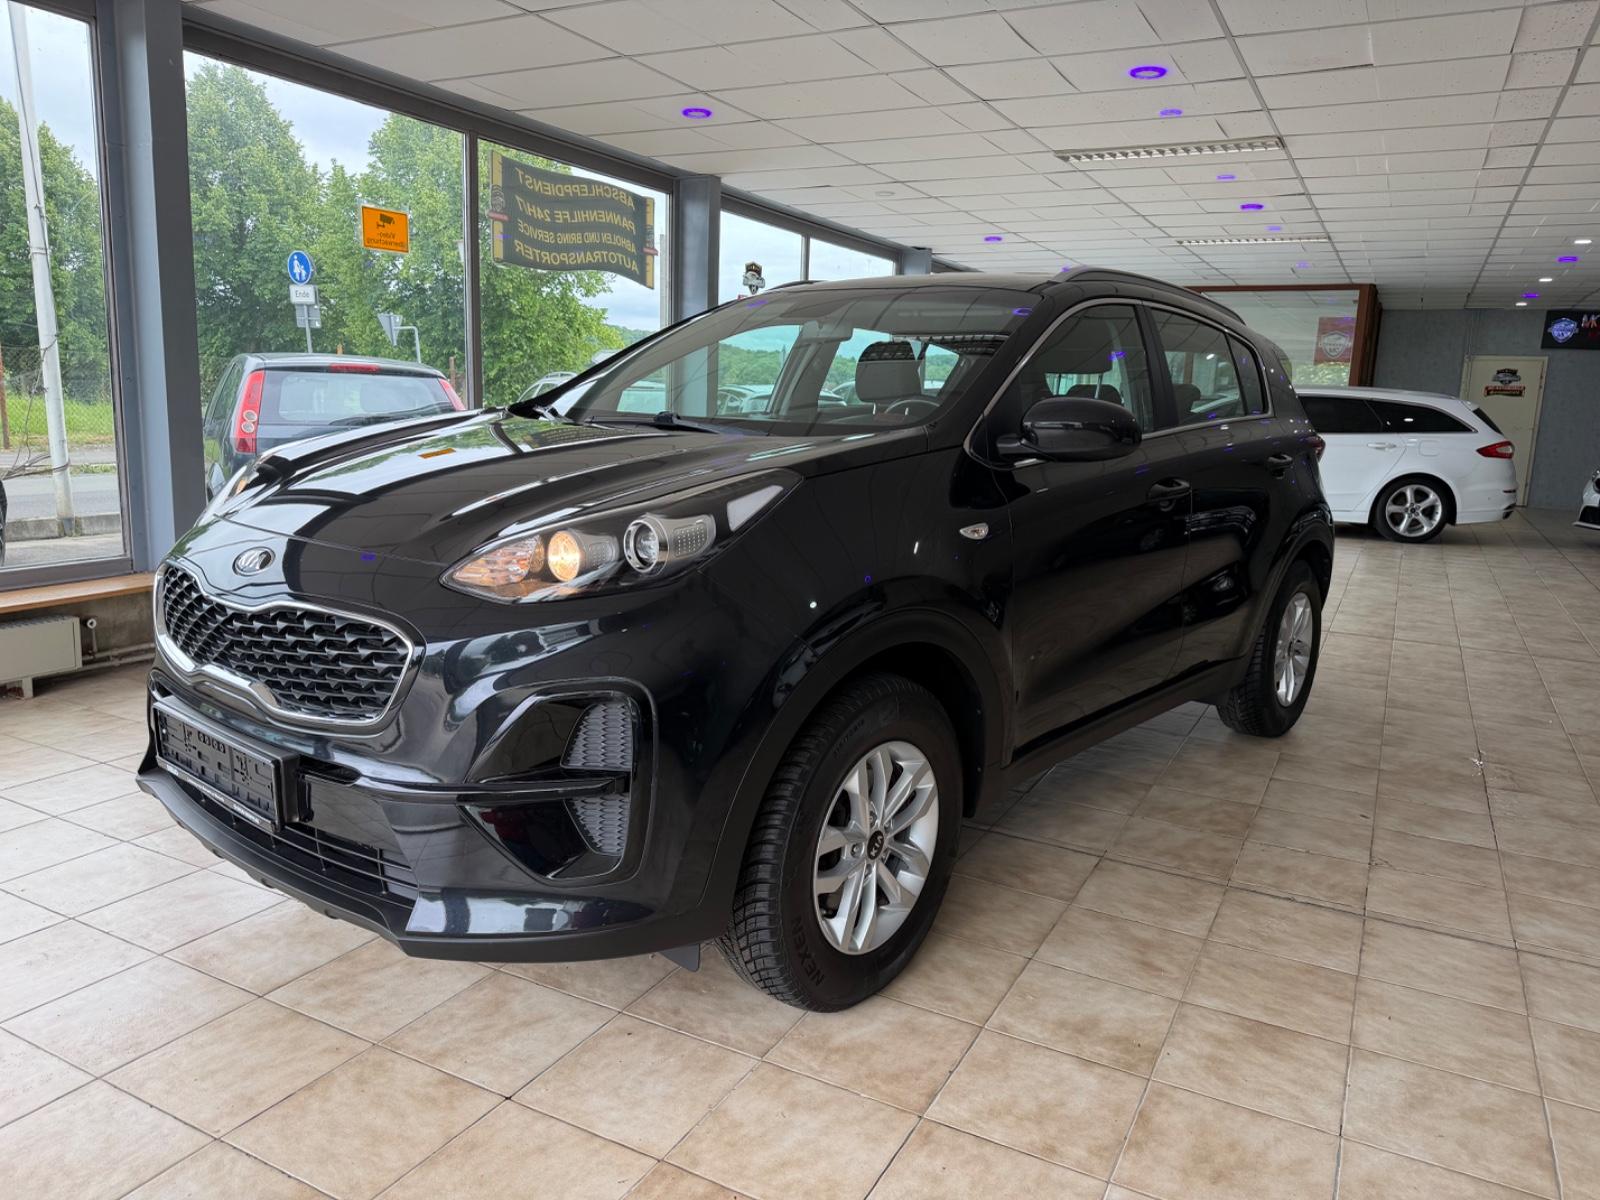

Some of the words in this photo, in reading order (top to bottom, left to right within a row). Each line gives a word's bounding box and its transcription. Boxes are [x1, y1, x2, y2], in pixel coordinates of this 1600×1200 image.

[295, 290, 310, 298] Ende
[870, 835, 883, 857] KIA
[791, 916, 825, 985] NEXEN
